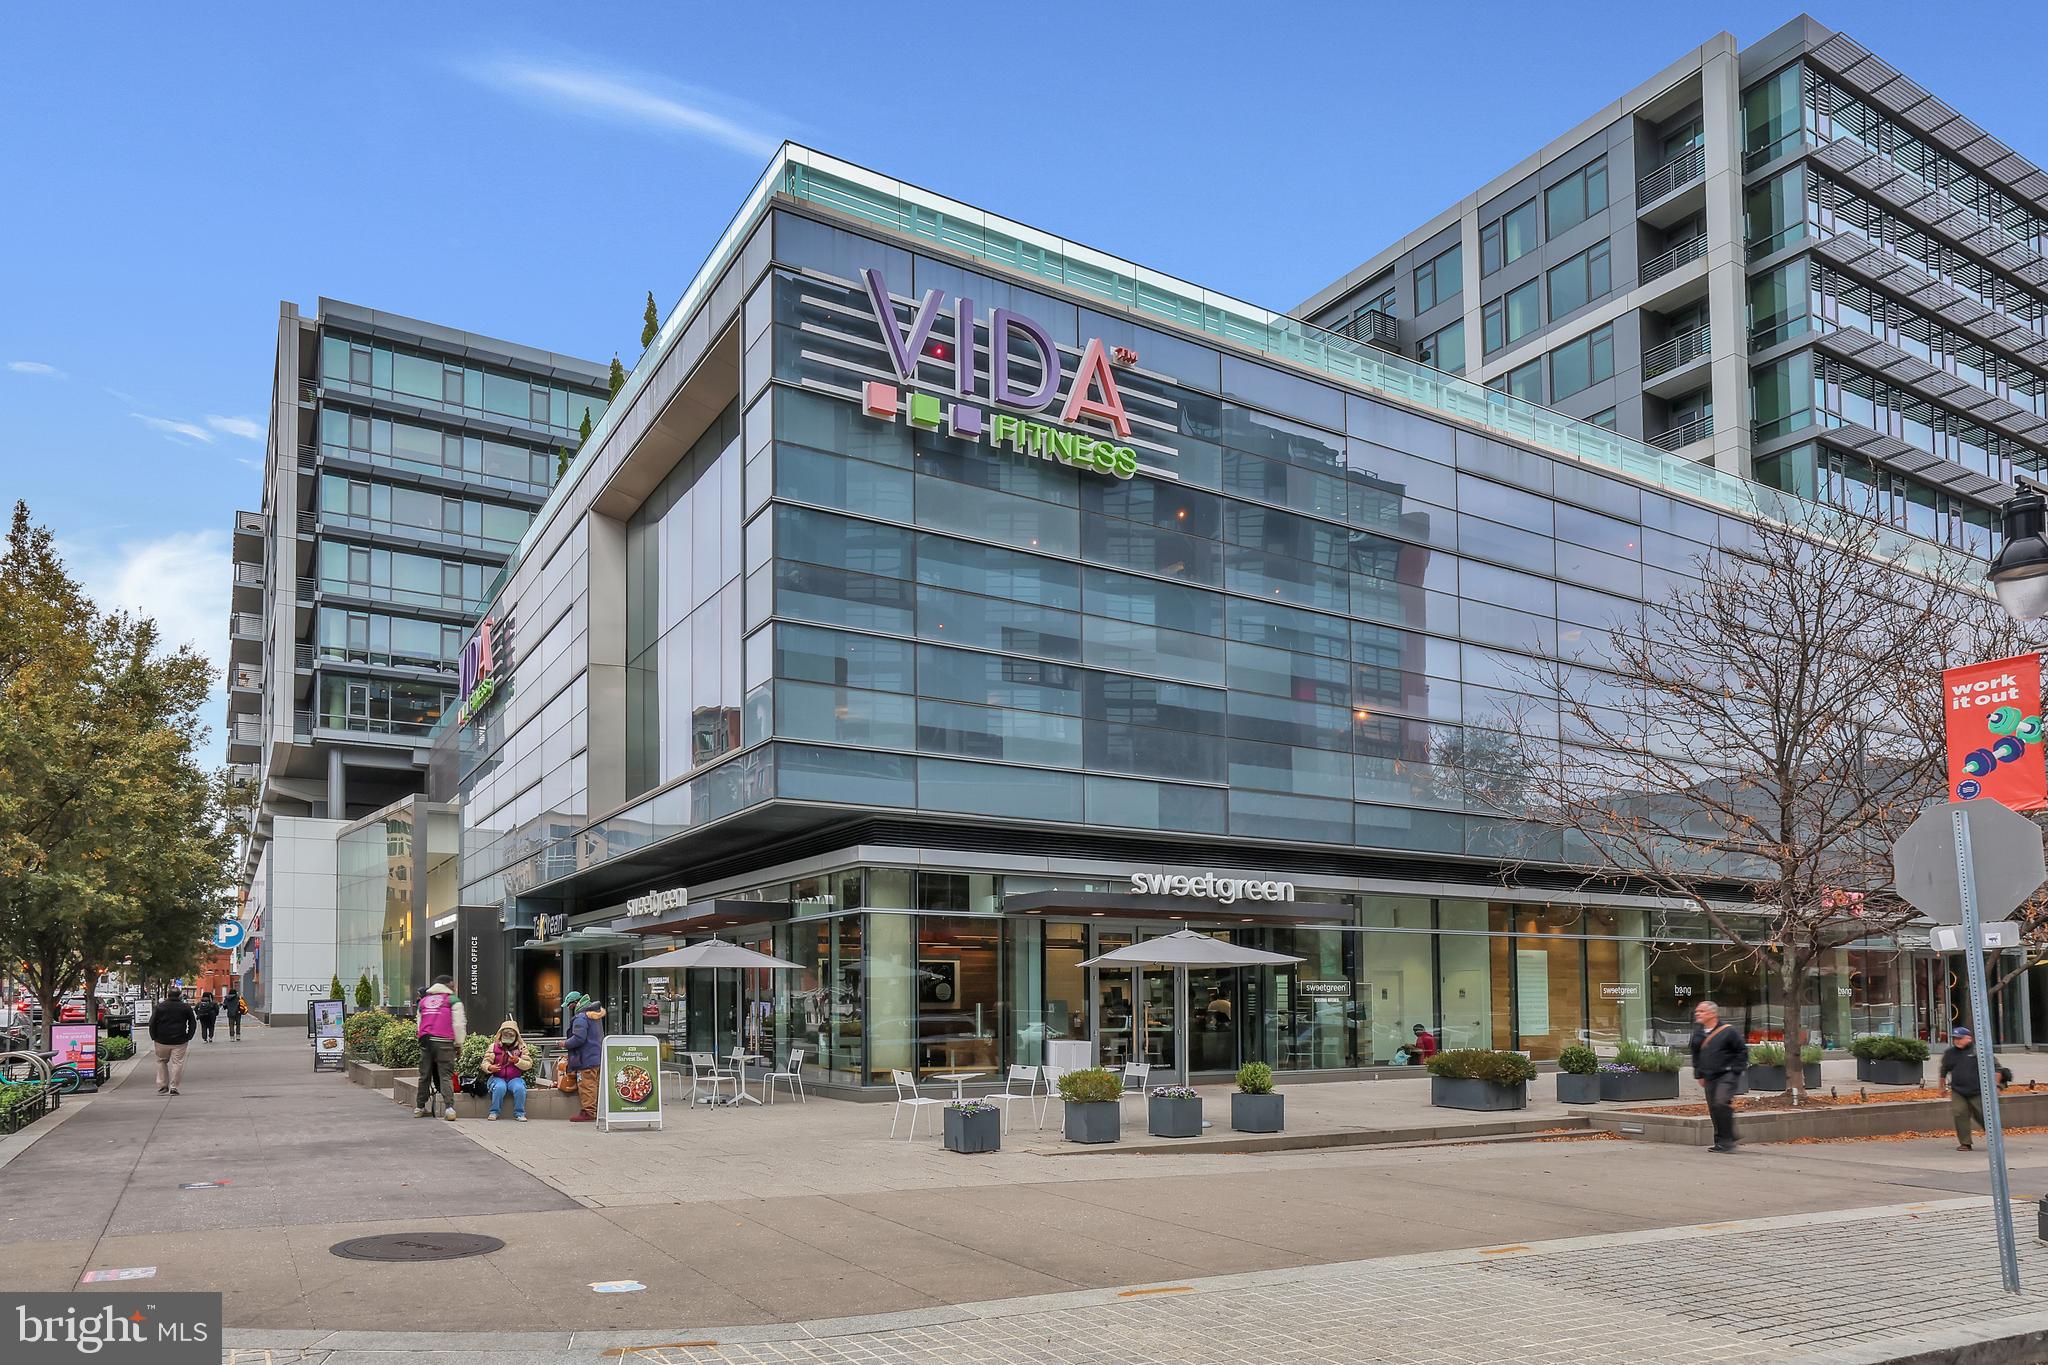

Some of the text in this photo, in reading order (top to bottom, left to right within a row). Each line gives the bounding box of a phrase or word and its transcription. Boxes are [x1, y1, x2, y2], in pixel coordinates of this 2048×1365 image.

[860, 267, 1132, 439] VIDA
[990, 413, 1138, 480] FITNESS
[1951, 673, 2017, 695] work
[1952, 687, 2020, 710] it out
[1130, 871, 1295, 905] sweetgreen
[626, 887, 688, 917] sweetgreen
[218, 923, 239, 943] P
[1305, 983, 1346, 993] sweetgreen
[1603, 986, 1638, 996] sweetgreen
[1674, 984, 1692, 996] bang
